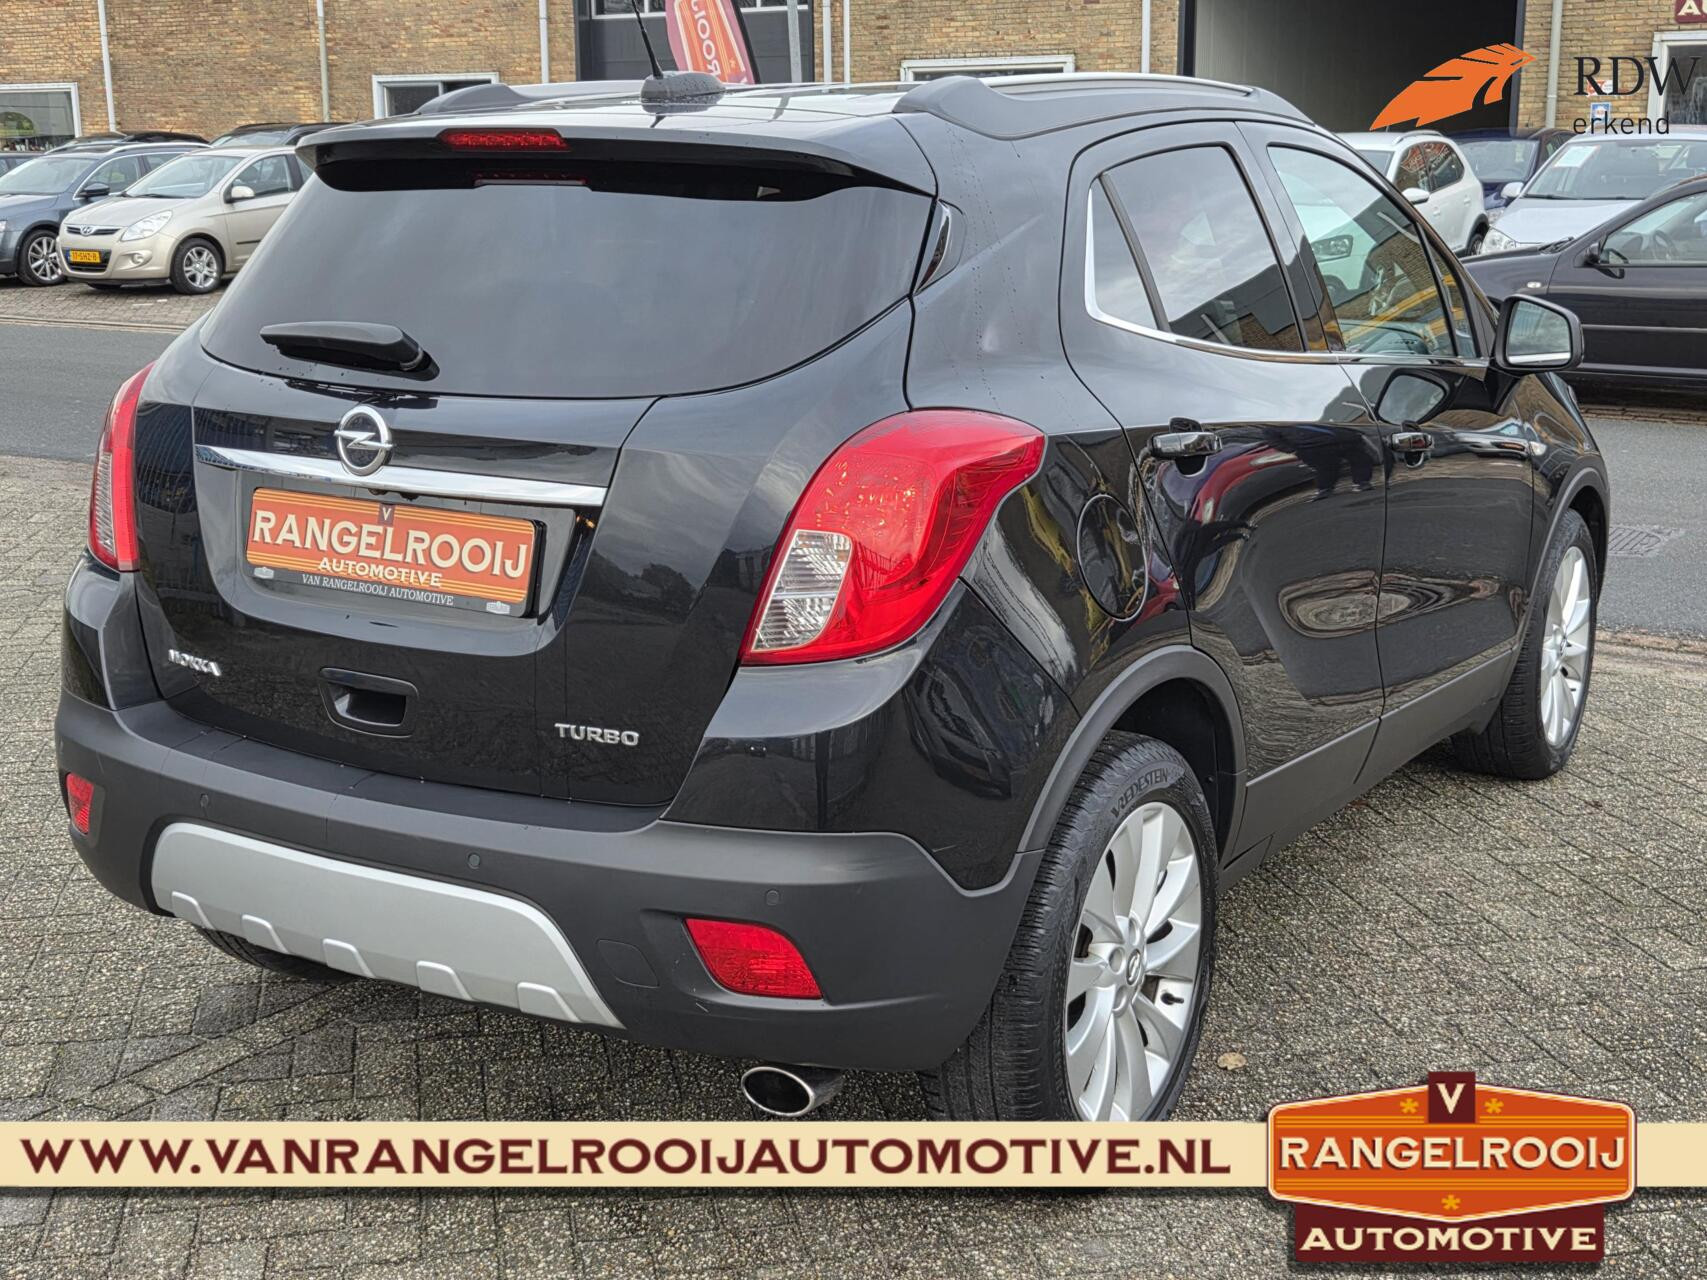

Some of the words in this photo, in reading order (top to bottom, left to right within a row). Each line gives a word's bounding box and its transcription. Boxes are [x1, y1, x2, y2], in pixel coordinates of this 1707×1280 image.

[381, 507, 392, 522] V
[252, 509, 528, 579] RANGELROOIJ
[317, 557, 443, 588] AUTOMOTIVE
[302, 573, 321, 587] VAN
[321, 577, 388, 597] RANGELROOIJ
[388, 589, 455, 606] AUTOMOTIVE
[554, 722, 639, 746] TURBO
[1110, 767, 1168, 818] VREDESTEIN
